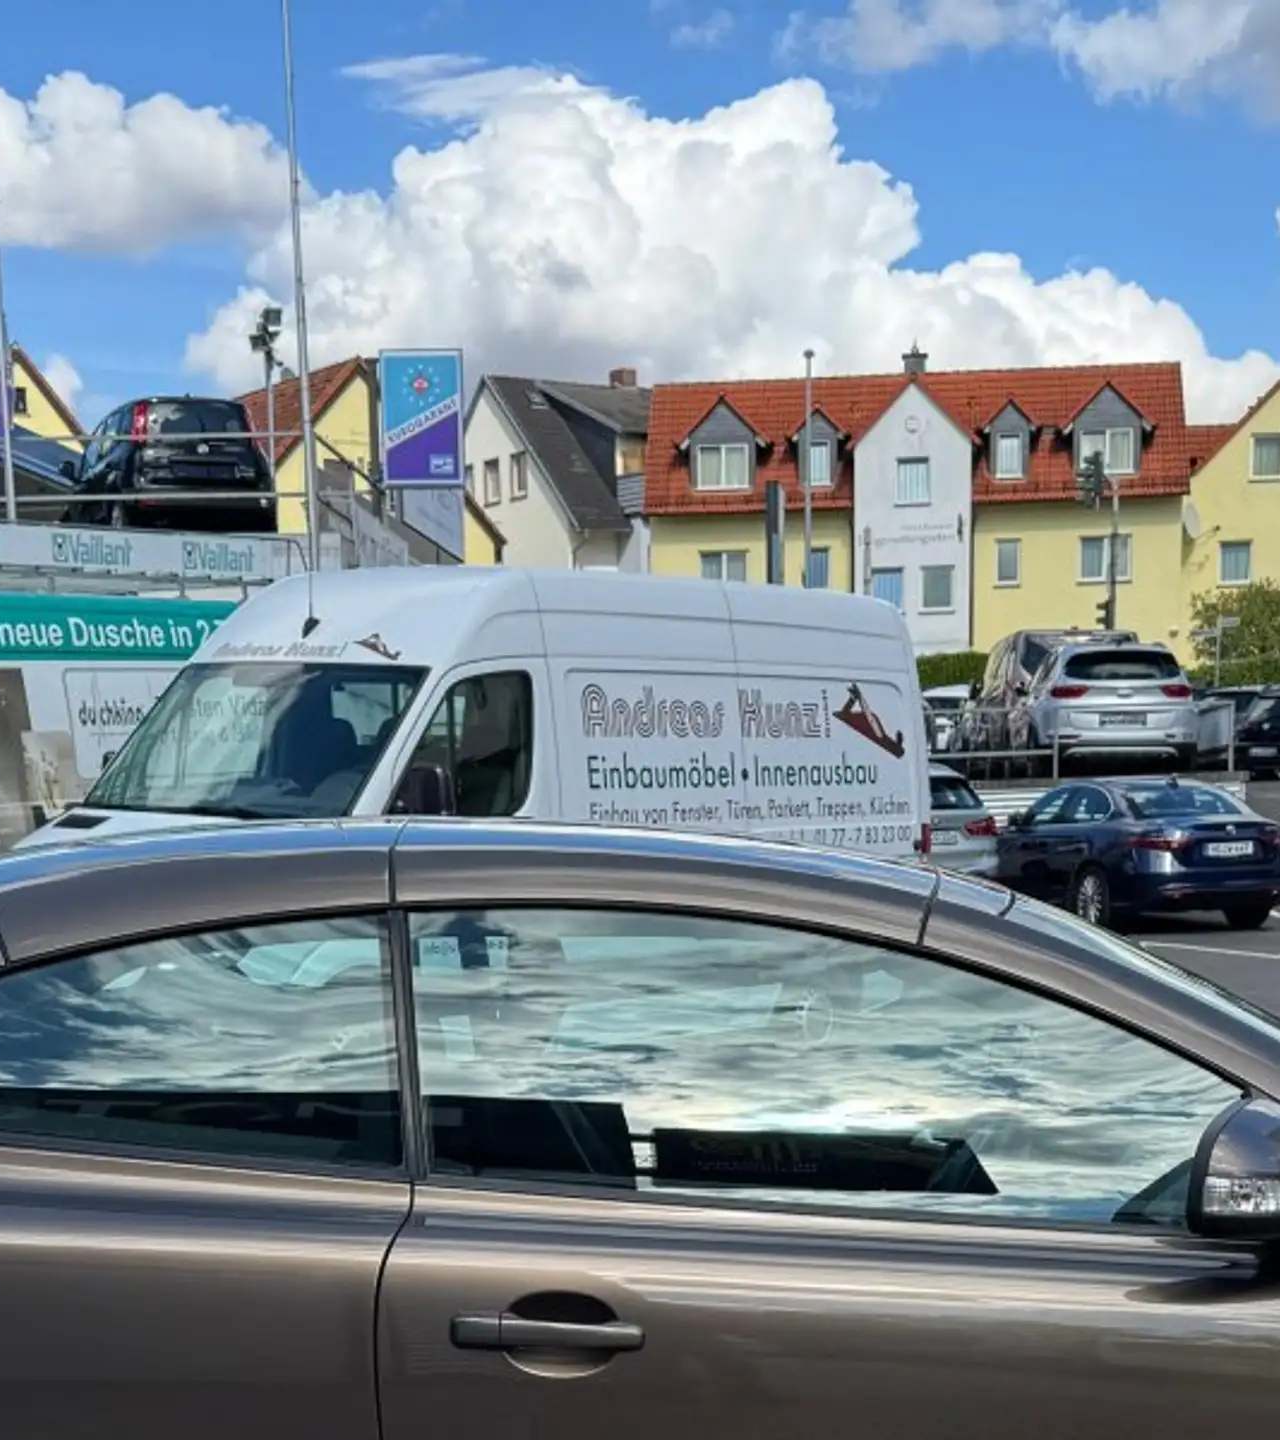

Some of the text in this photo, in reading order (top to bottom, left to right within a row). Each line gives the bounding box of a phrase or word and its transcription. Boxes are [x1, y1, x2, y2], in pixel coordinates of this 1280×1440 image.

[68, 536, 133, 567] Vaillant
[194, 543, 254, 572] Vaillant
[67, 616, 165, 648] Dusche
[168, 619, 193, 648] in
[581, 683, 726, 738] Andreas
[737, 688, 821, 739] Kunz
[586, 750, 879, 790] Einbaumöbel Innenausbau
[672, 801, 721, 823] Fenster,
[768, 798, 812, 820] Parkett,
[816, 796, 867, 821] Treppen,
